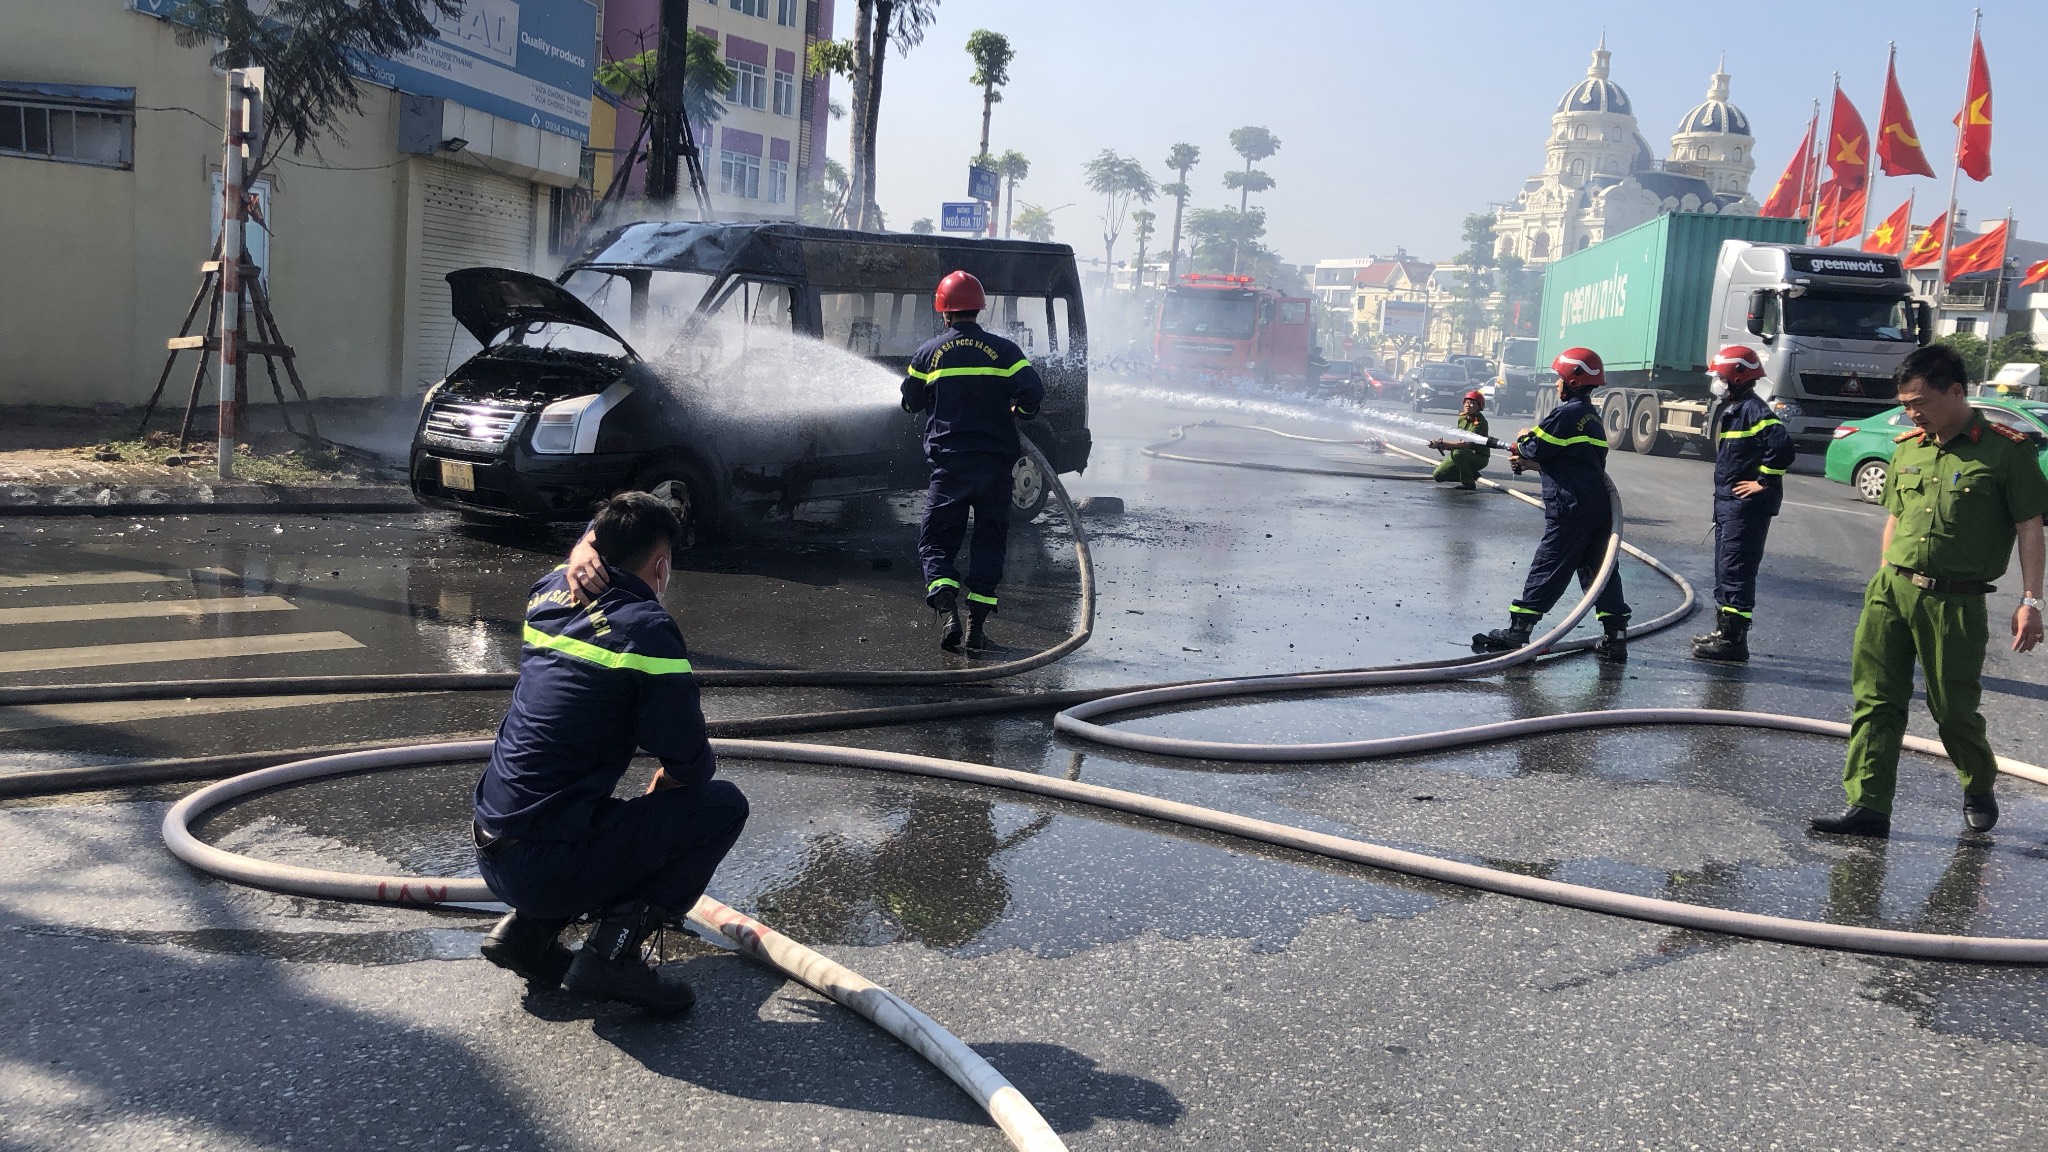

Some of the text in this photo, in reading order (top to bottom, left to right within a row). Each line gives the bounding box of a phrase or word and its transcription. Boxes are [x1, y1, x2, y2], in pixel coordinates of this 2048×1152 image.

[521, 31, 586, 68] Quality products
[416, 52, 452, 72] POLYUREA
[960, 216, 971, 227] GIA
[1811, 258, 1885, 273] greenworks
[1560, 260, 1628, 339] greenworks
[955, 338, 974, 346] PCCC
[589, 609, 612, 637] NCH
